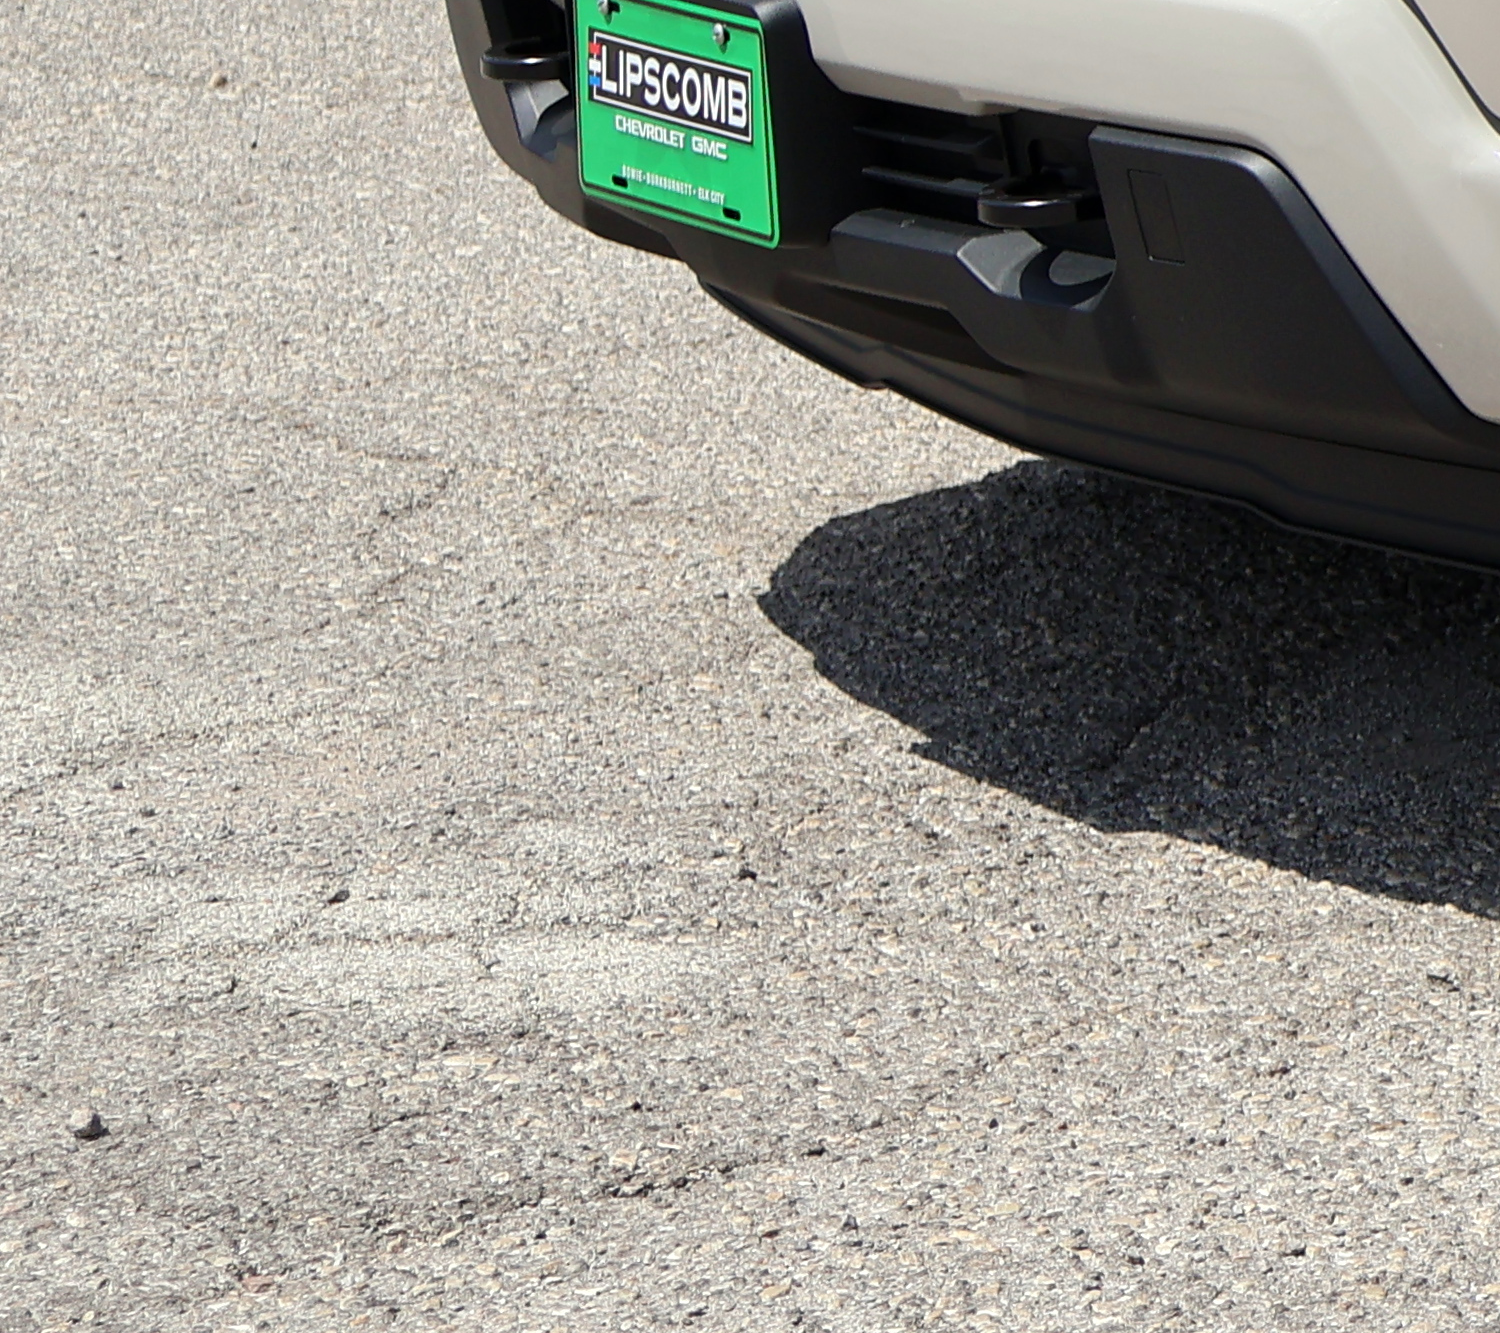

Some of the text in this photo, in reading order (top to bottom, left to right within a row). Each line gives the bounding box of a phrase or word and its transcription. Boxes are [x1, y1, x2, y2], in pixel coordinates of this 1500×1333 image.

[600, 43, 748, 129] LIPSCOMB
[615, 114, 728, 161] CHEVROLET GMC
[698, 186, 710, 201] ELK
[710, 190, 725, 206] CITY
